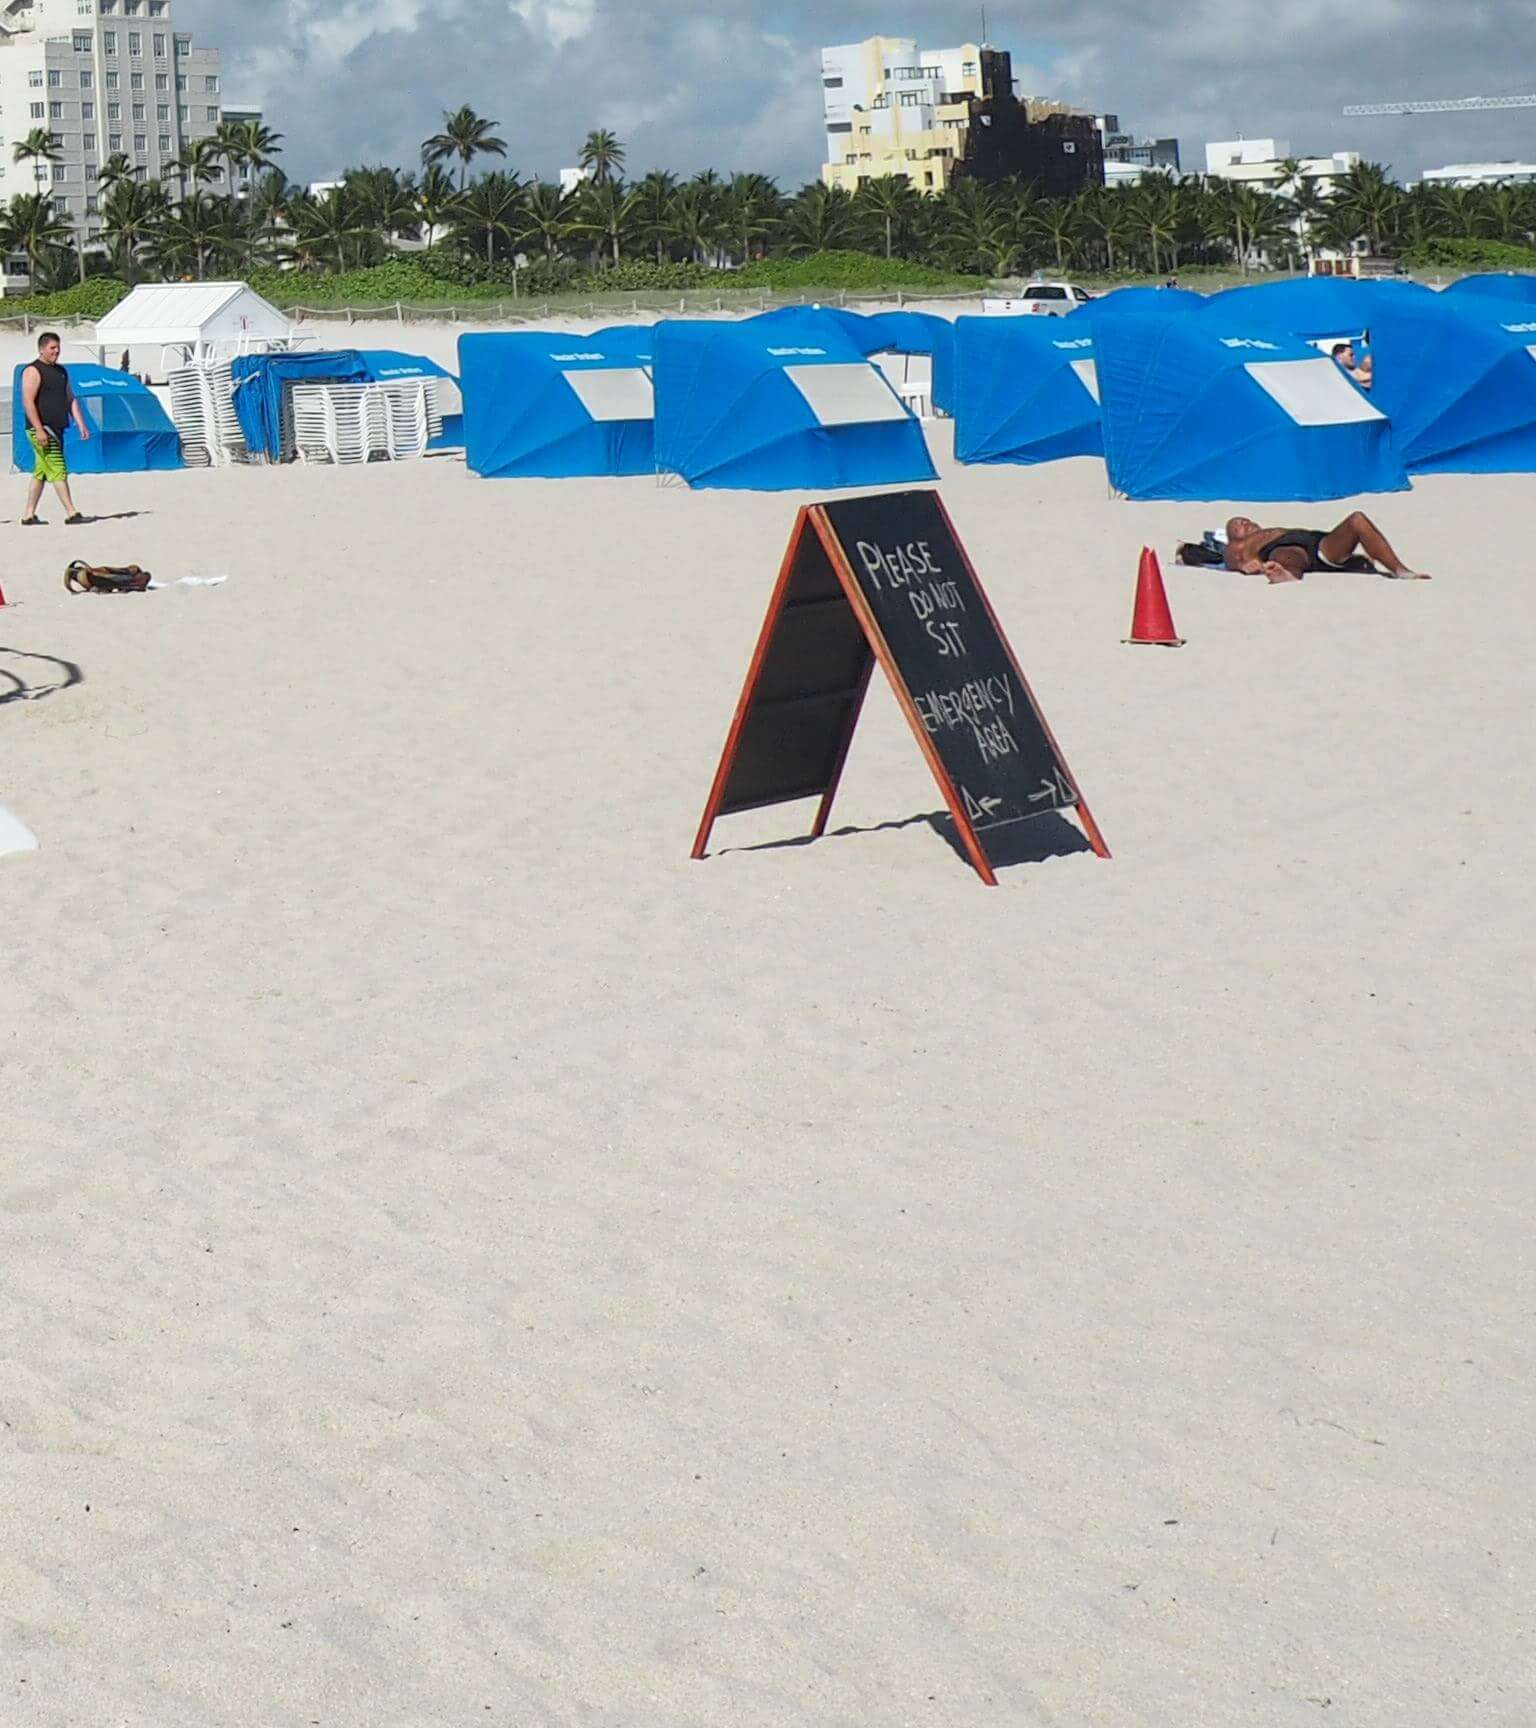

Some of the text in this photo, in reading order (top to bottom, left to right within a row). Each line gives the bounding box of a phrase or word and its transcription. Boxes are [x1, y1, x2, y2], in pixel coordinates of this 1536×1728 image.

[856, 540, 942, 591] PLEASE
[909, 581, 967, 620] DO NOT
[914, 672, 1015, 733] EMERGENCY
[974, 714, 1019, 765] AREA
